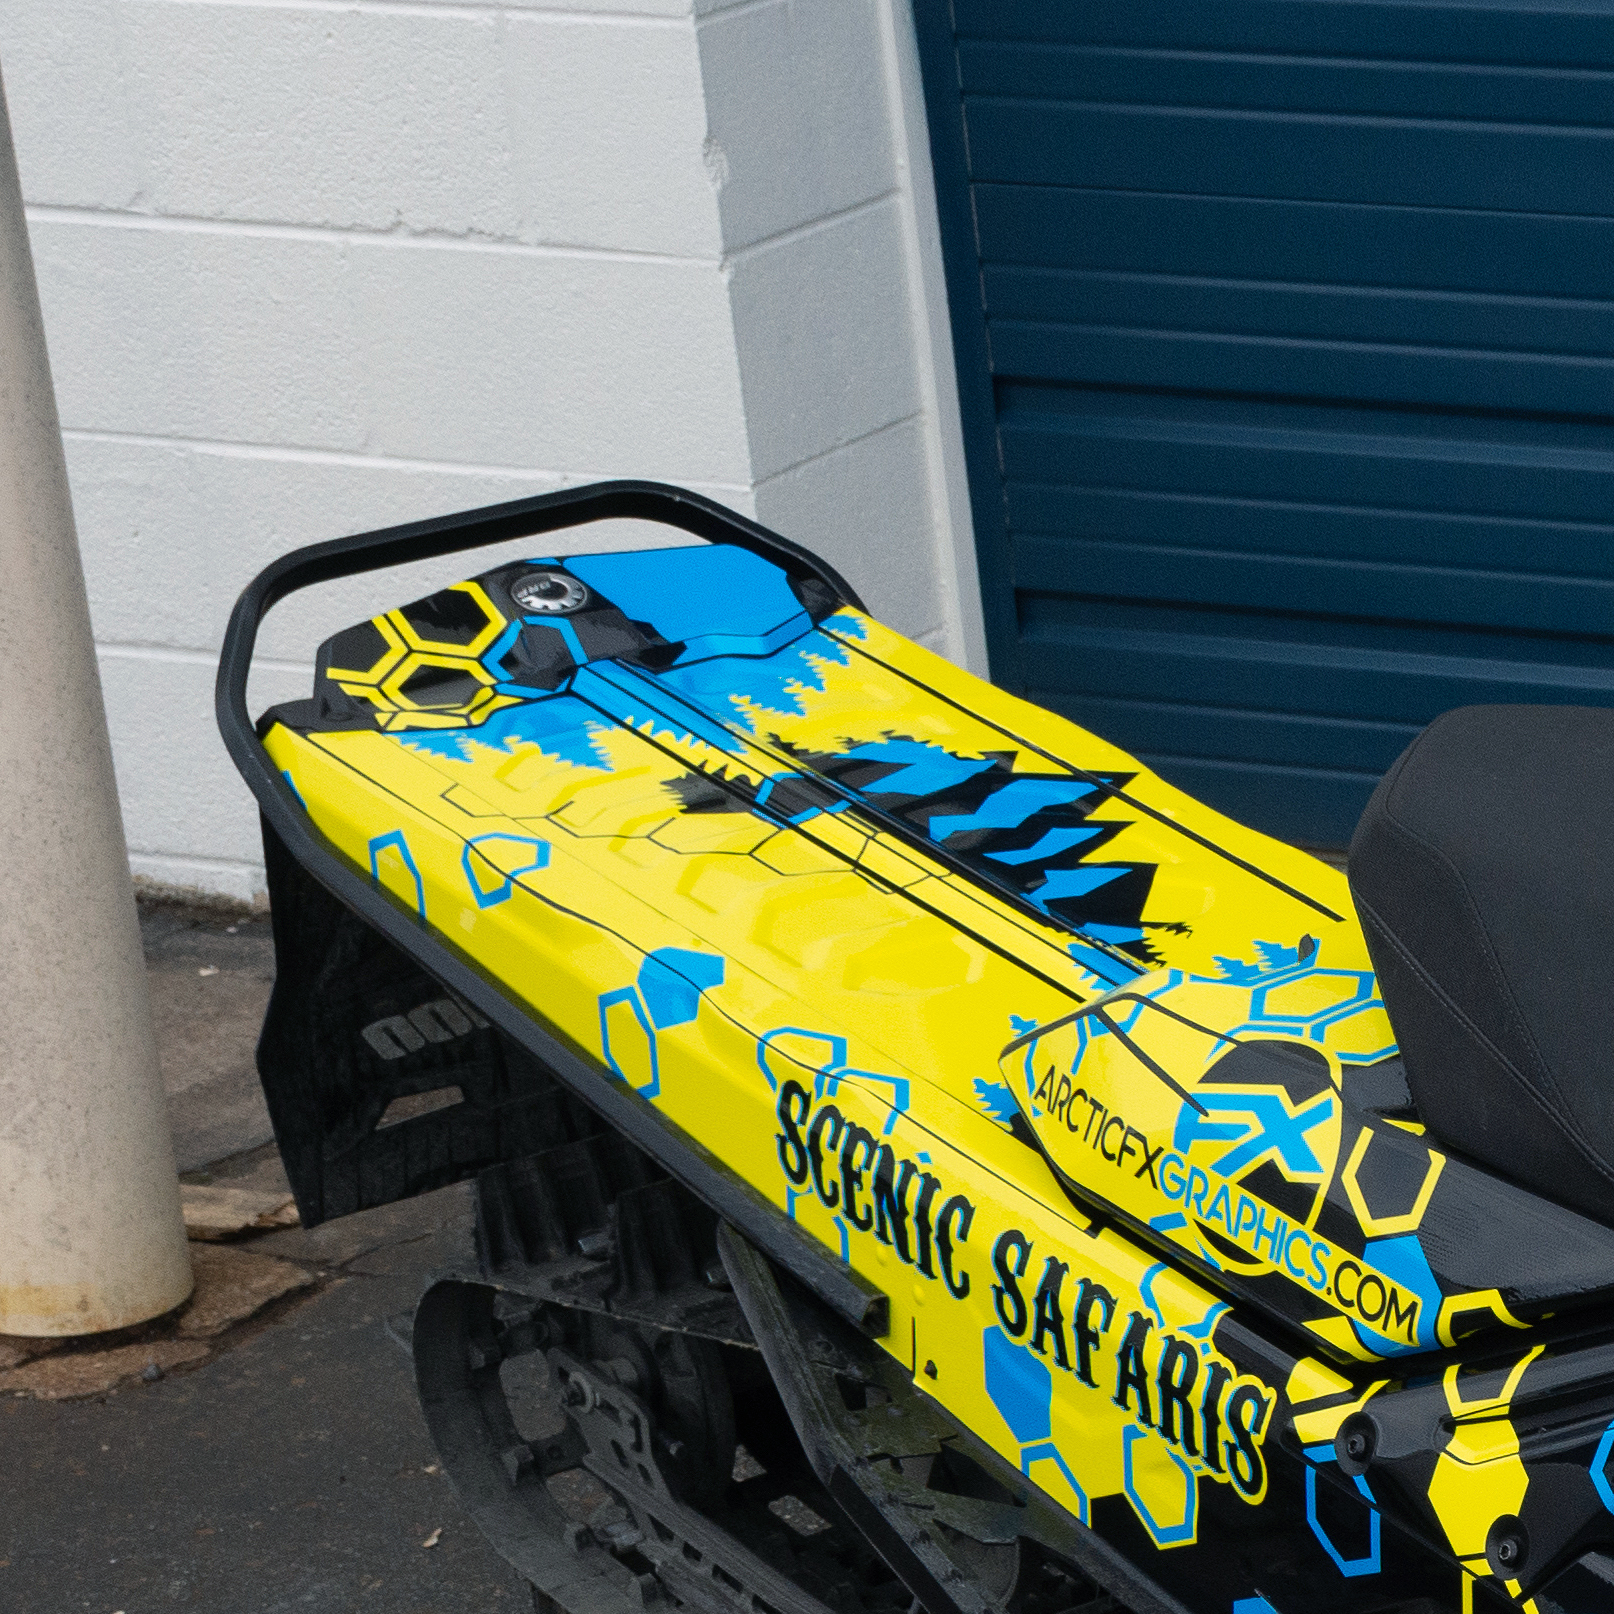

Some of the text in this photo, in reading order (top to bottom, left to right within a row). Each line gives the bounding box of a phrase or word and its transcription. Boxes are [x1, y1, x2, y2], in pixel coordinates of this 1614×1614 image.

[775, 1079, 1272, 1496] SCENIC SAFARIS
[1035, 1064, 1419, 1344] ARCTICFXGRAPHICS.COM
